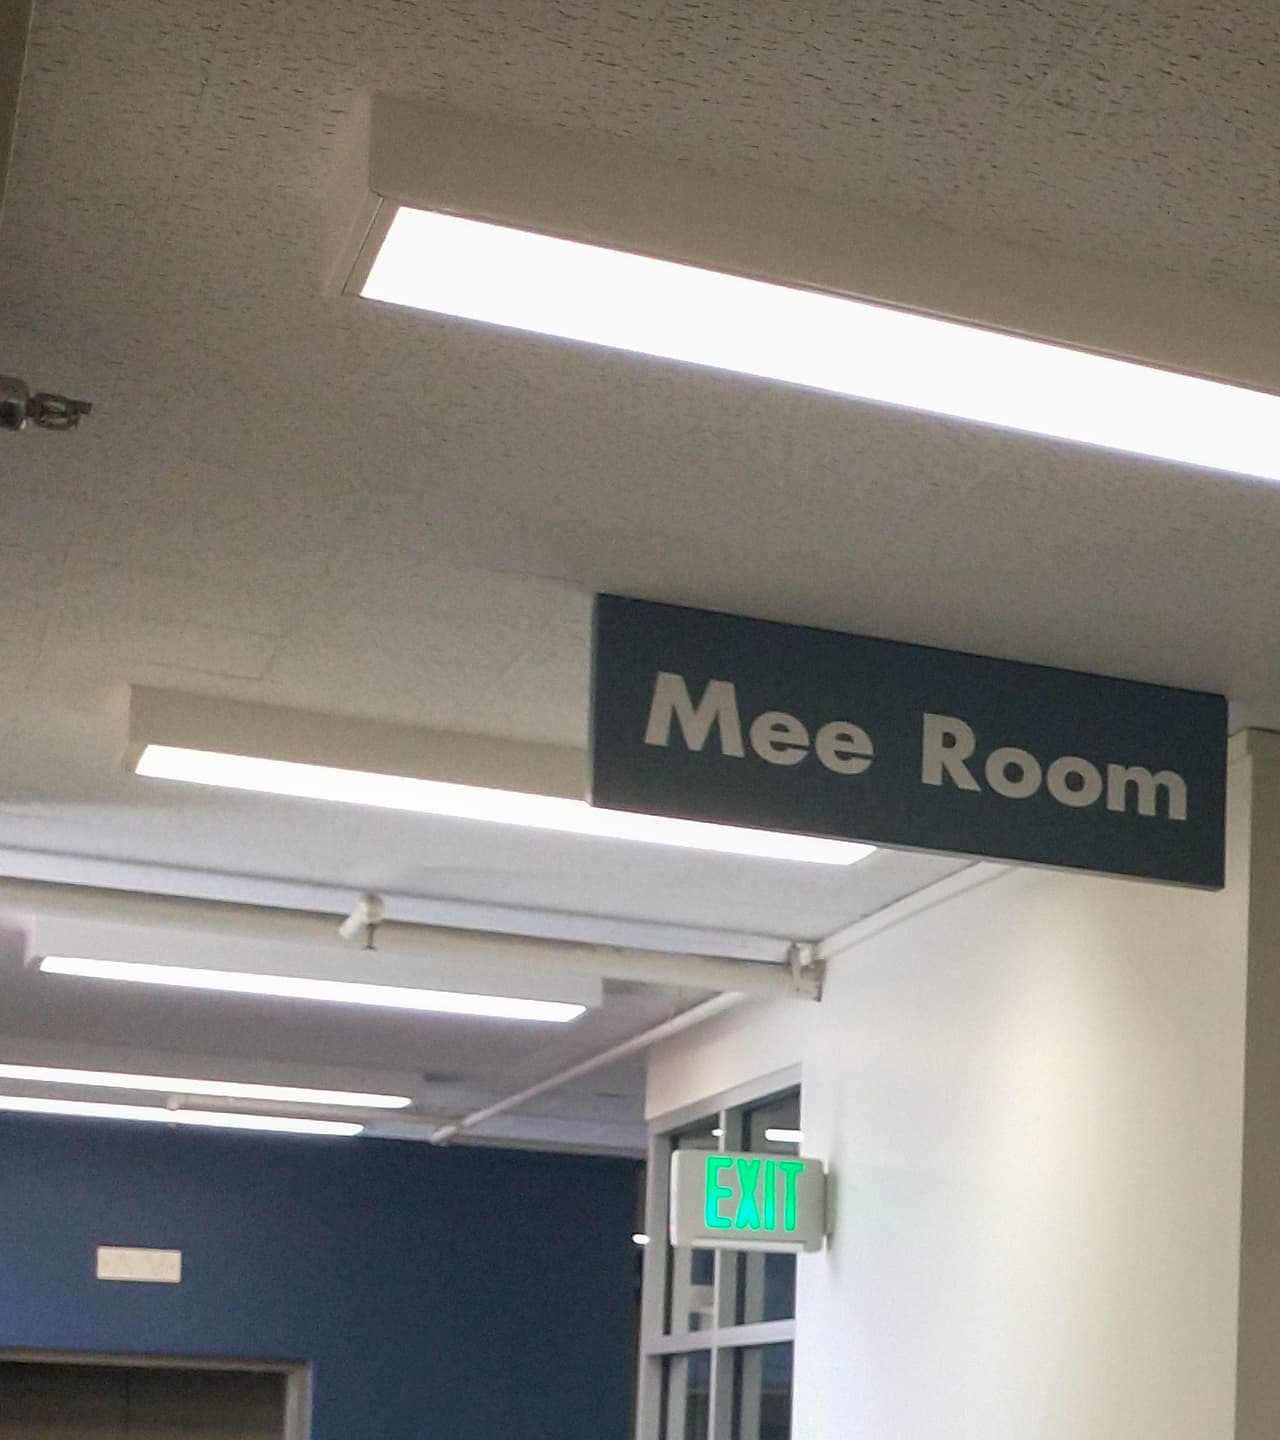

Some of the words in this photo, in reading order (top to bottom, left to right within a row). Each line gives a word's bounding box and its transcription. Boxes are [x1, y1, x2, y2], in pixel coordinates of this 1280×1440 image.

[644, 671, 875, 775] Mee
[921, 712, 1188, 820] Room
[705, 1155, 805, 1232] EXIT
